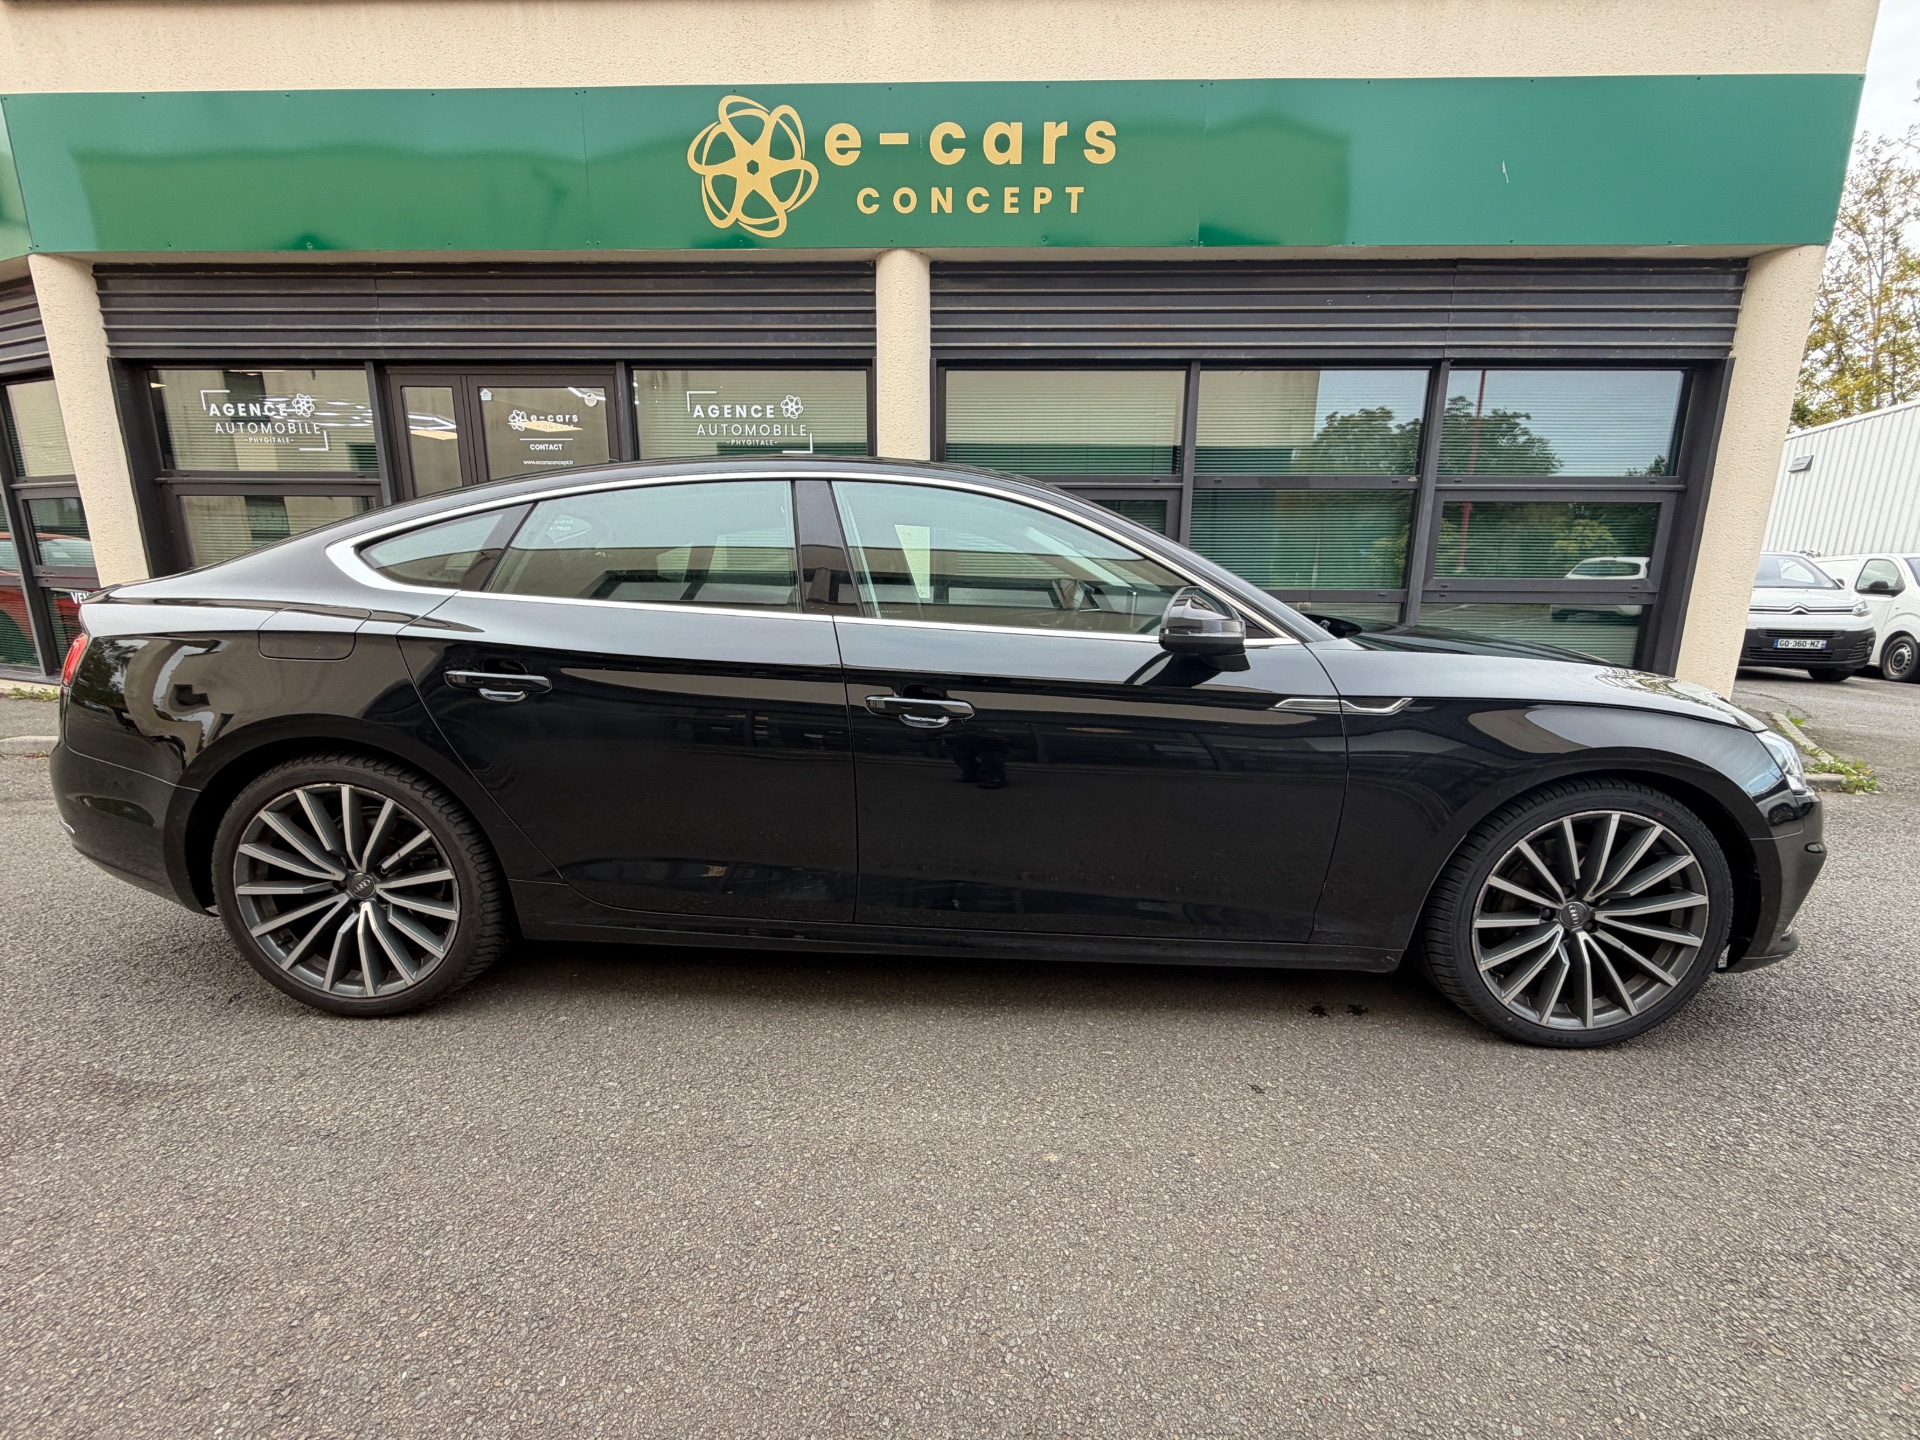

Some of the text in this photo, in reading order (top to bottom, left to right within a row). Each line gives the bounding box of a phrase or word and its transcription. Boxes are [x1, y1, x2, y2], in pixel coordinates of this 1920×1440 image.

[824, 120, 1117, 166] e-cars
[856, 186, 1085, 214] CONCEPT
[209, 403, 288, 416] AGENCE
[692, 404, 775, 418] AGENCE
[530, 414, 578, 422] e-cars
[215, 422, 321, 434] AUTOMOBILE
[696, 424, 807, 436] AUTOMOBILE
[529, 443, 563, 451] CONTACT
